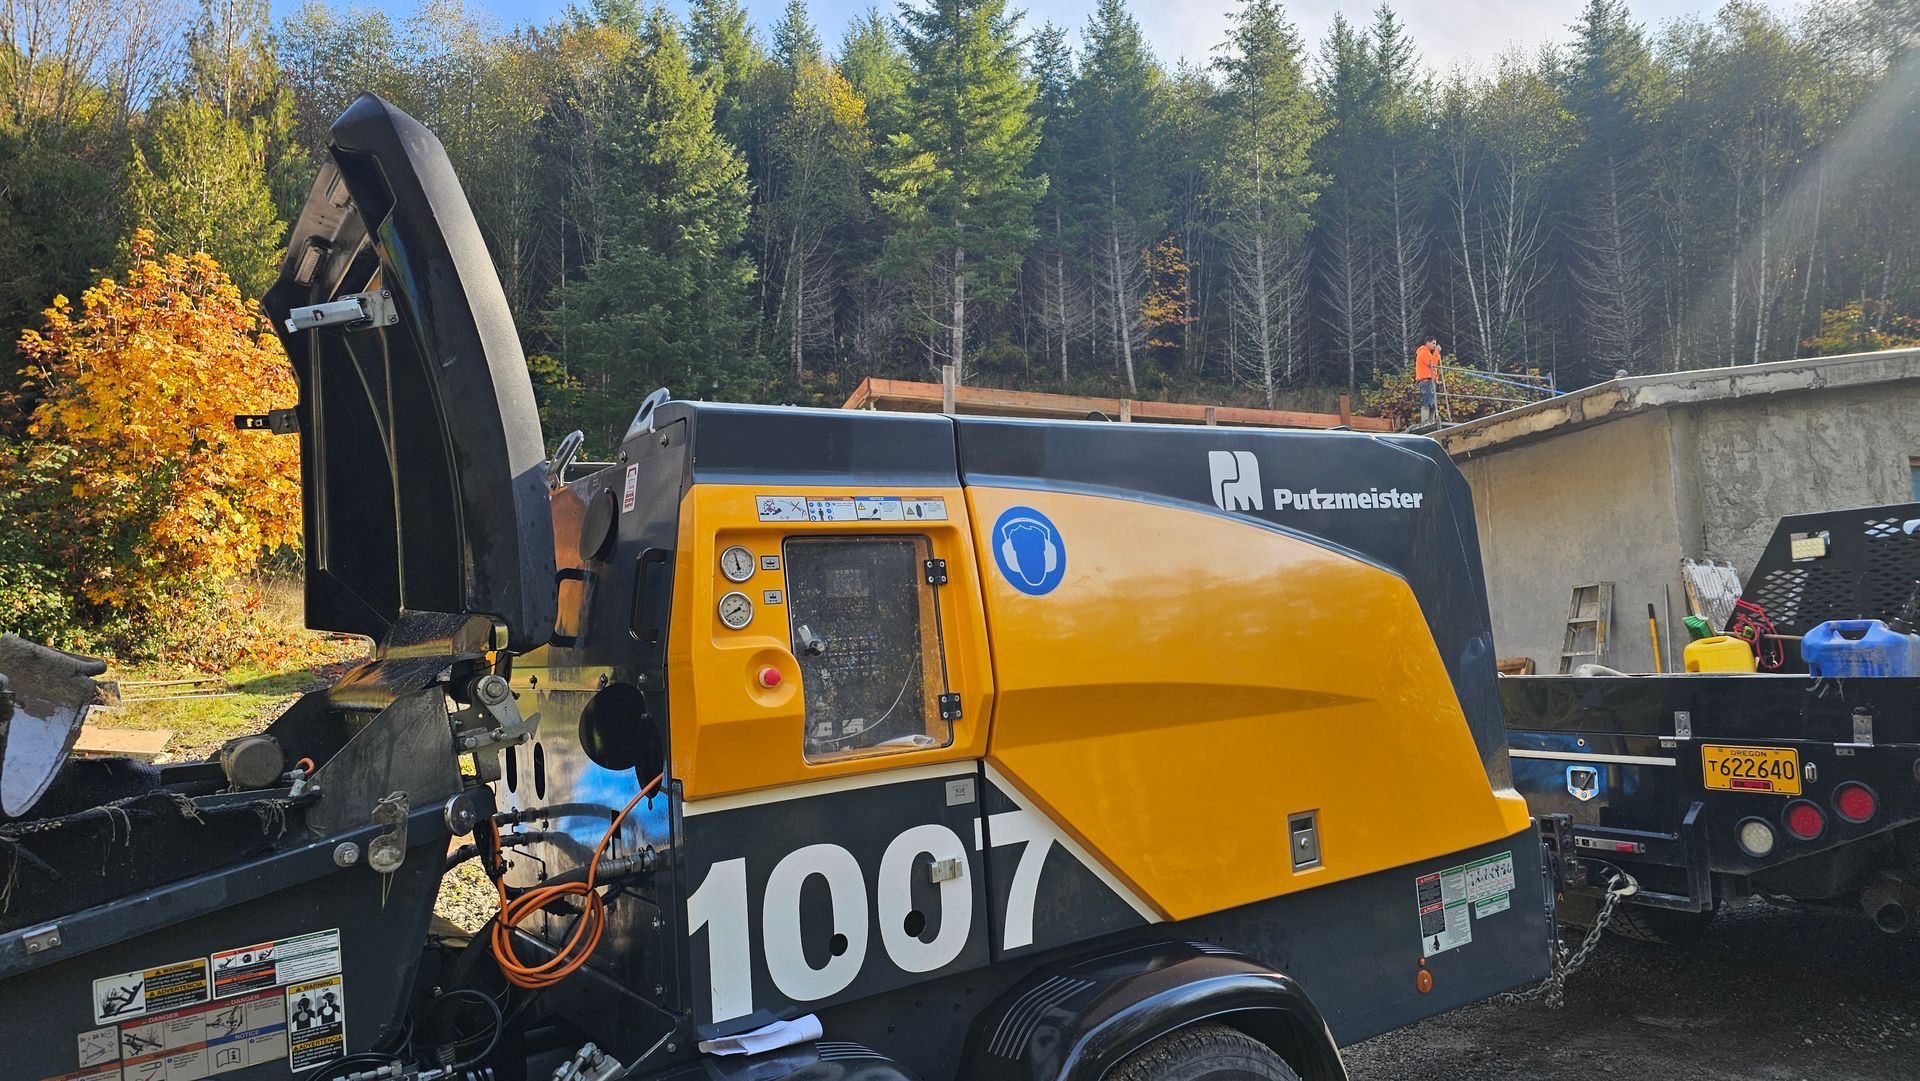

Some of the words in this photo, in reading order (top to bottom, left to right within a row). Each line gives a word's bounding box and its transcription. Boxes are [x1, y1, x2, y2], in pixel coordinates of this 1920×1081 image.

[1273, 487, 1424, 511] Putzmeister
[1730, 749, 1767, 757] OREGON
[1708, 757, 1795, 780] T622640
[687, 810, 1055, 1024] 1007
[163, 962, 194, 974] WARNING
[157, 981, 204, 995] ADVERTENCIA
[303, 979, 334, 991] WARNING
[230, 994, 260, 1005] DANGER
[148, 1012, 179, 1023] DANGER
[235, 1030, 260, 1040] NOTICE
[300, 1034, 342, 1050] ADVERTENCIA
